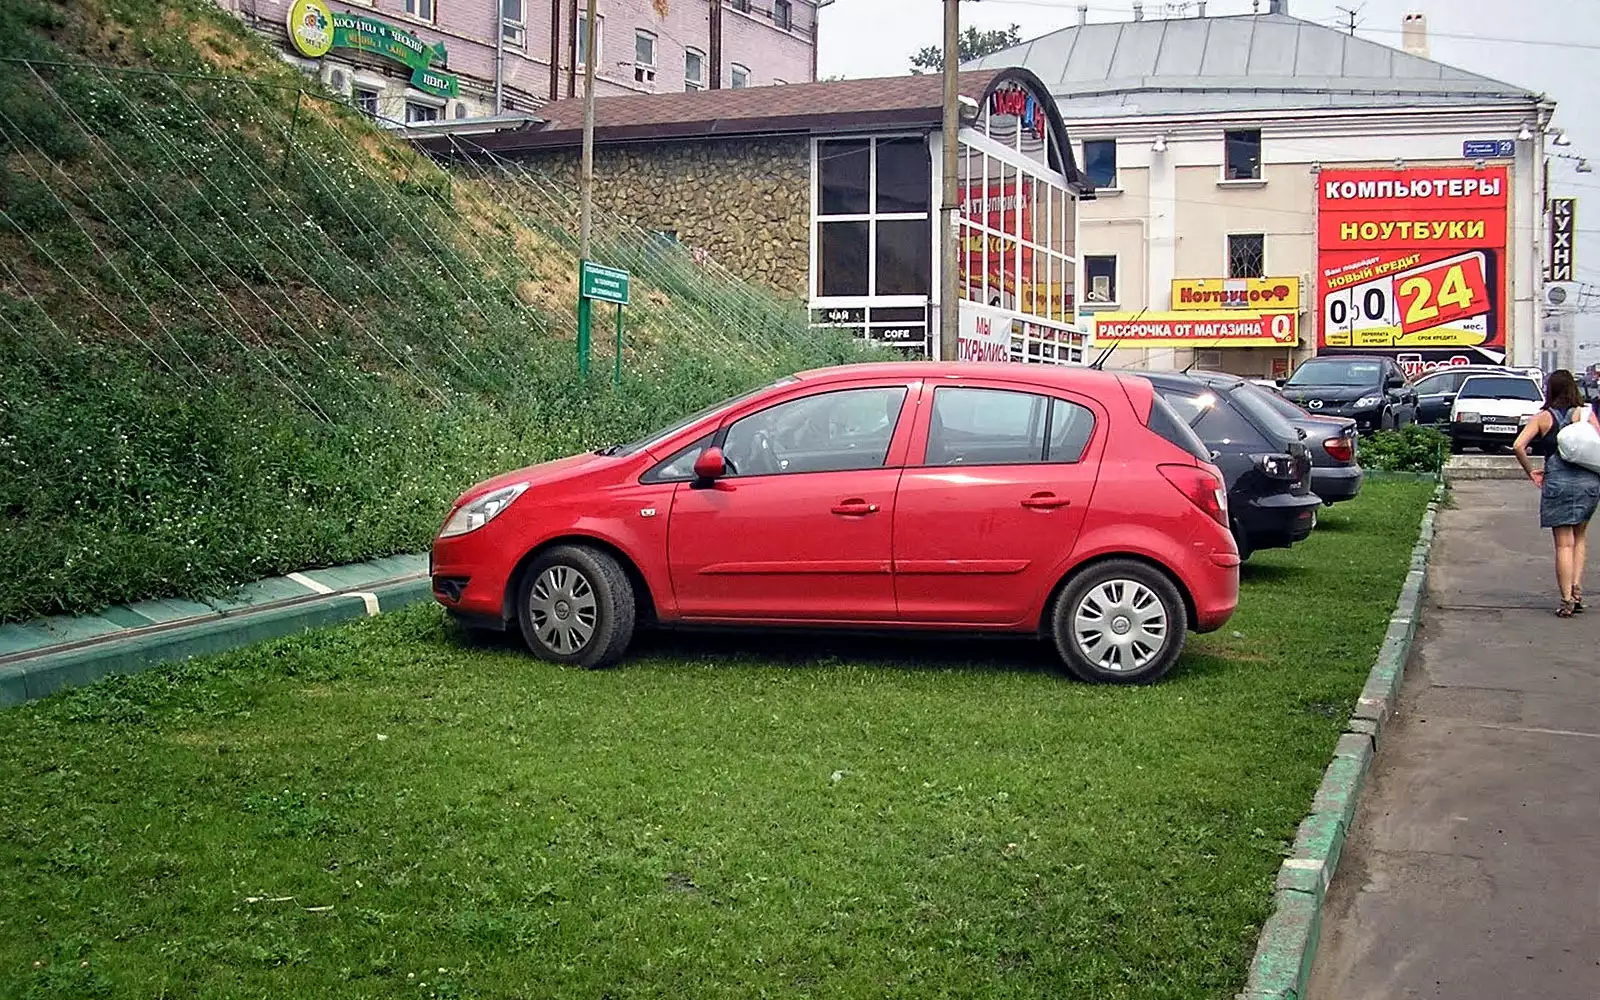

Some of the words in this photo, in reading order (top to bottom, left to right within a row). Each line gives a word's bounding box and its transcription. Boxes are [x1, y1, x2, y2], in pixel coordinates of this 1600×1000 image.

[1325, 178, 1500, 199] КОМПЬЮТЕРЫ
[1340, 221, 1485, 240] НОУТБУКИ
[1553, 200, 1571, 280] КУХНИ
[1327, 268, 1373, 288] НОВЫЙ
[1376, 254, 1421, 274] КРЕДИТ
[1363, 288, 1385, 321] 0
[1399, 265, 1474, 325] 24
[1330, 300, 1347, 324] 0
[884, 329, 910, 338] COFE
[976, 316, 992, 336] МЫ
[1099, 324, 1172, 337] РАССРОЧКА
[1174, 324, 1191, 336] ОТ
[1194, 322, 1262, 336] МАГАЗИНА
[957, 337, 1008, 362] ТКРЫЛИСЬ
